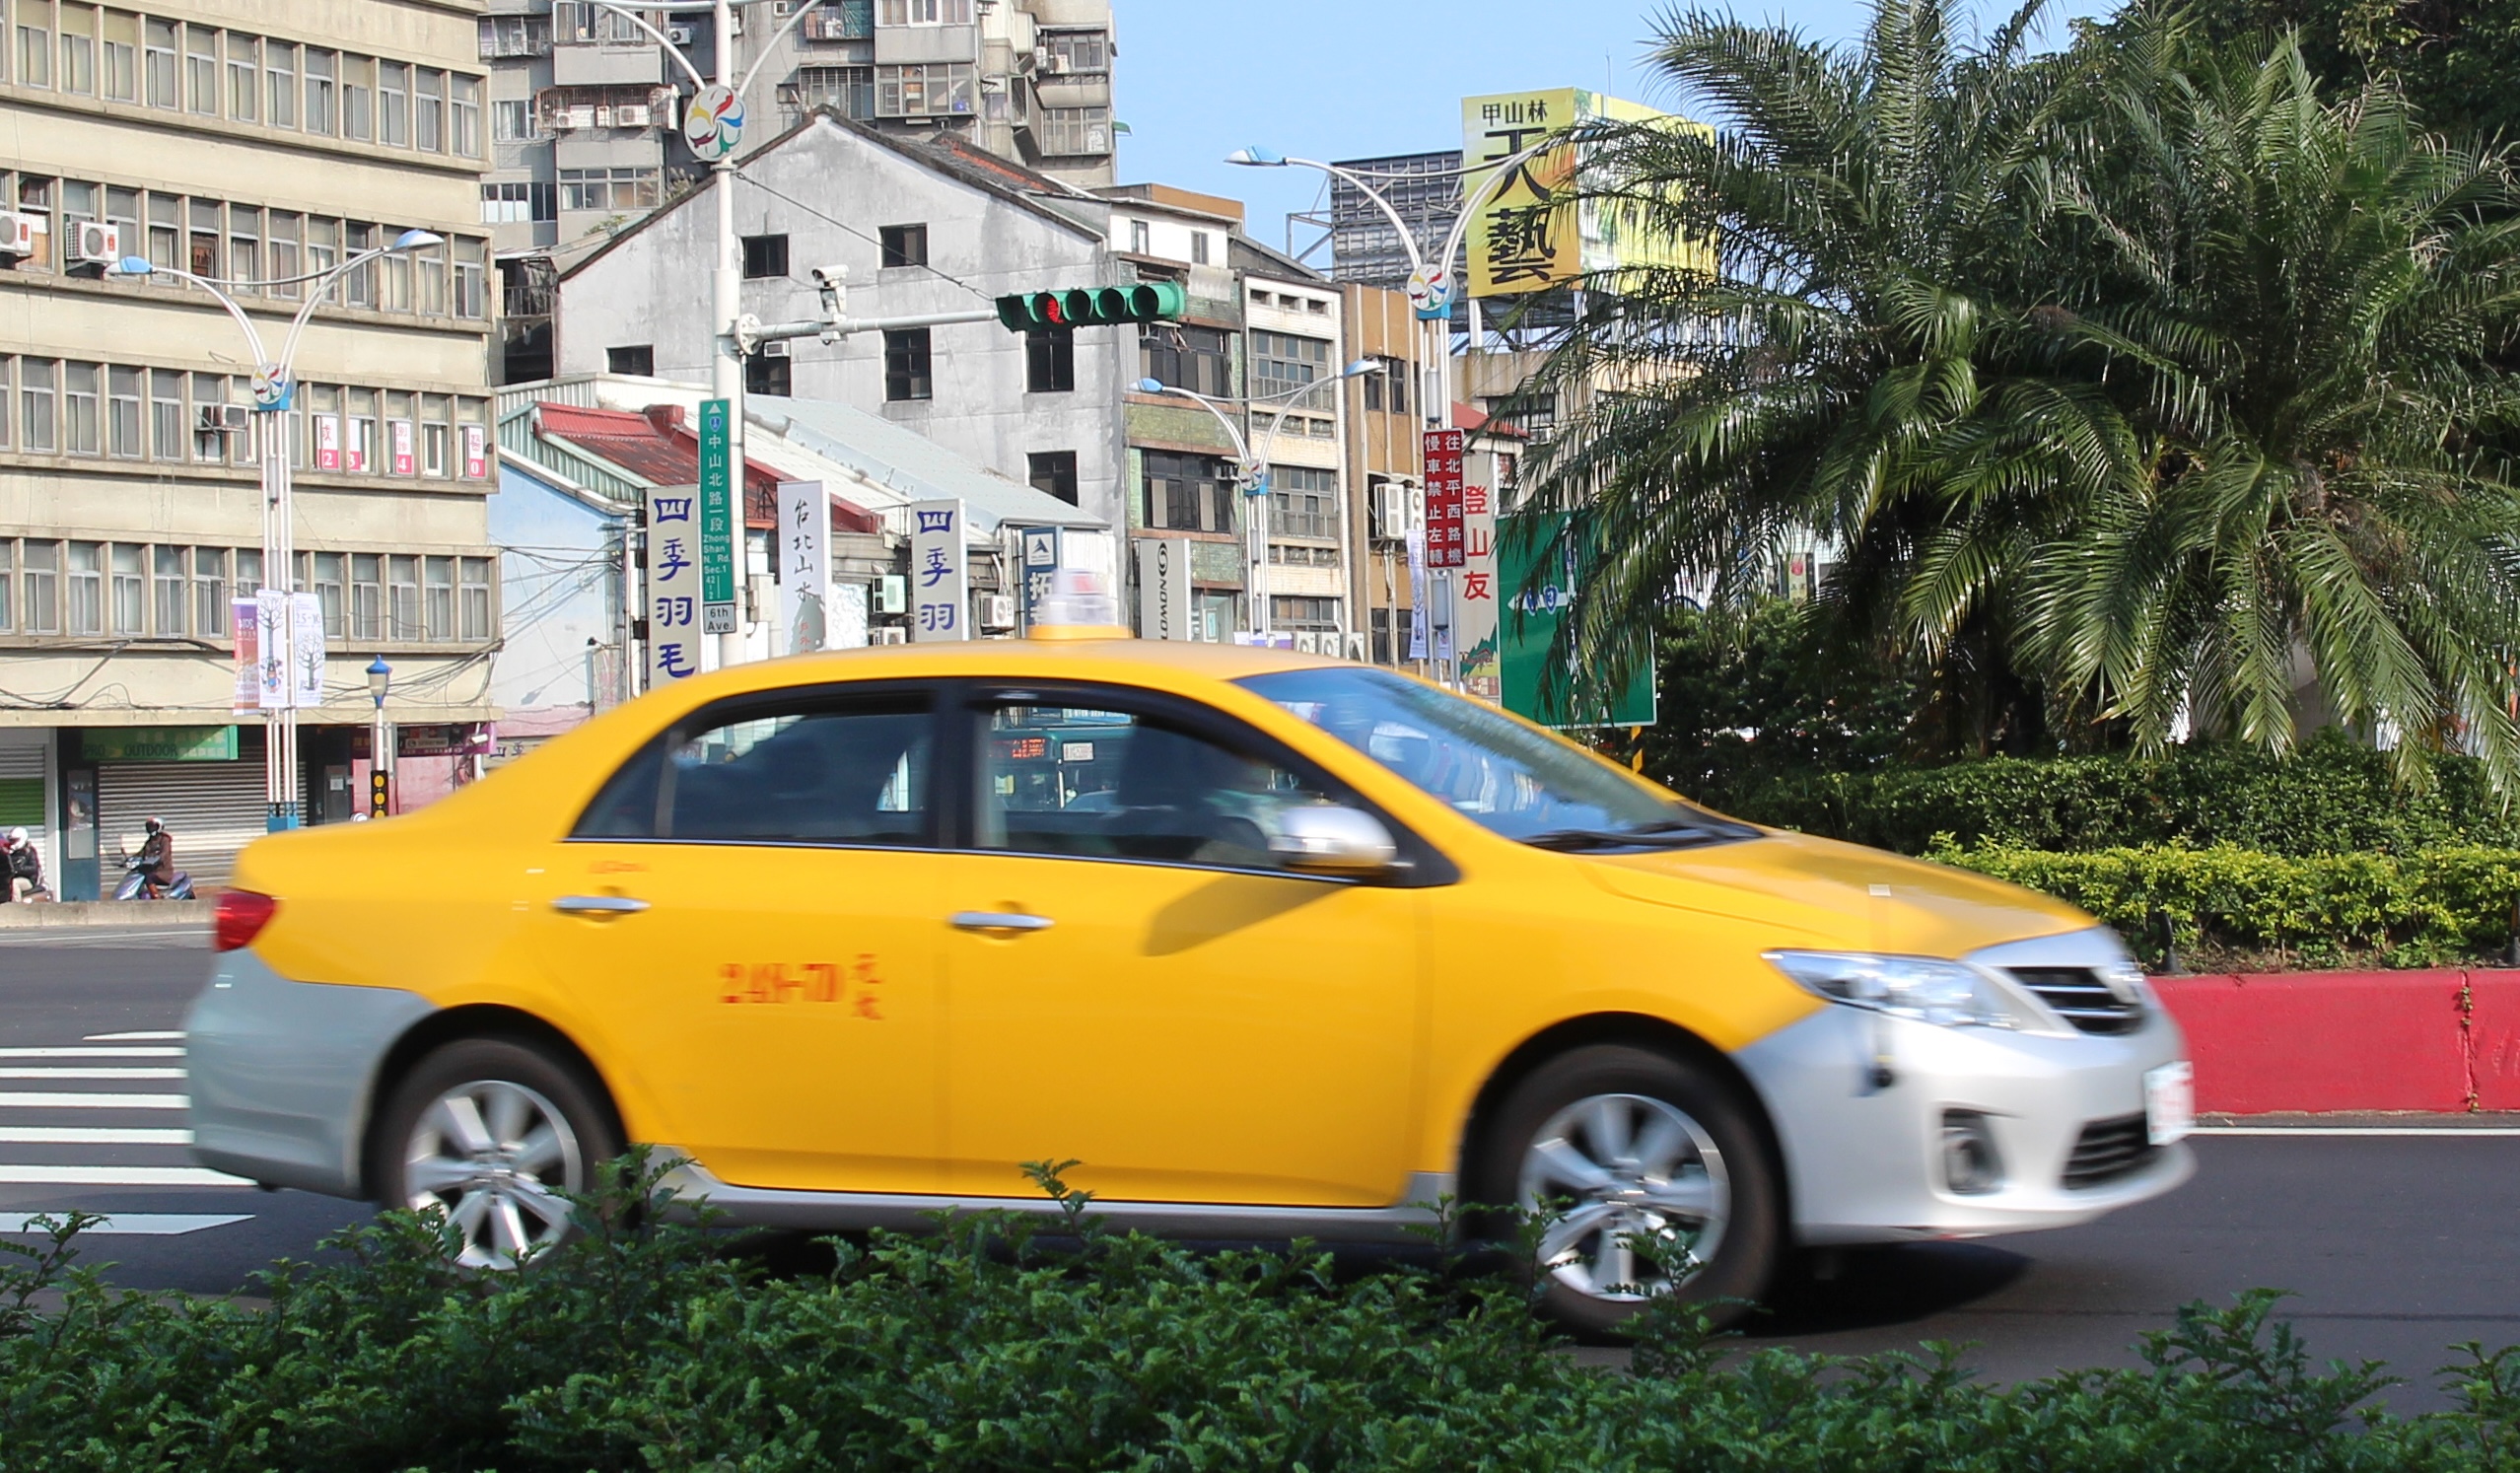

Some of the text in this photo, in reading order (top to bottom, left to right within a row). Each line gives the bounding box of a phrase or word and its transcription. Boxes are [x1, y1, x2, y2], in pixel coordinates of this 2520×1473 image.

[1482, 100, 1548, 127] 甲山林
[1484, 127, 1556, 285] 天藝
[323, 453, 333, 466] 2
[397, 457, 407, 471] 4
[708, 434, 725, 532] 中山北路一段
[1425, 436, 1444, 566] 慢車禁止左轉
[1445, 435, 1463, 565] 往北平西路機
[703, 534, 731, 543] Zhong
[717, 554, 731, 563] Rd.
[1463, 485, 1491, 600] 登山友
[654, 498, 696, 678] 四季羽毛
[917, 510, 955, 631] 四季羽
[707, 621, 733, 630] Ave.
[710, 608, 729, 618] 6th
